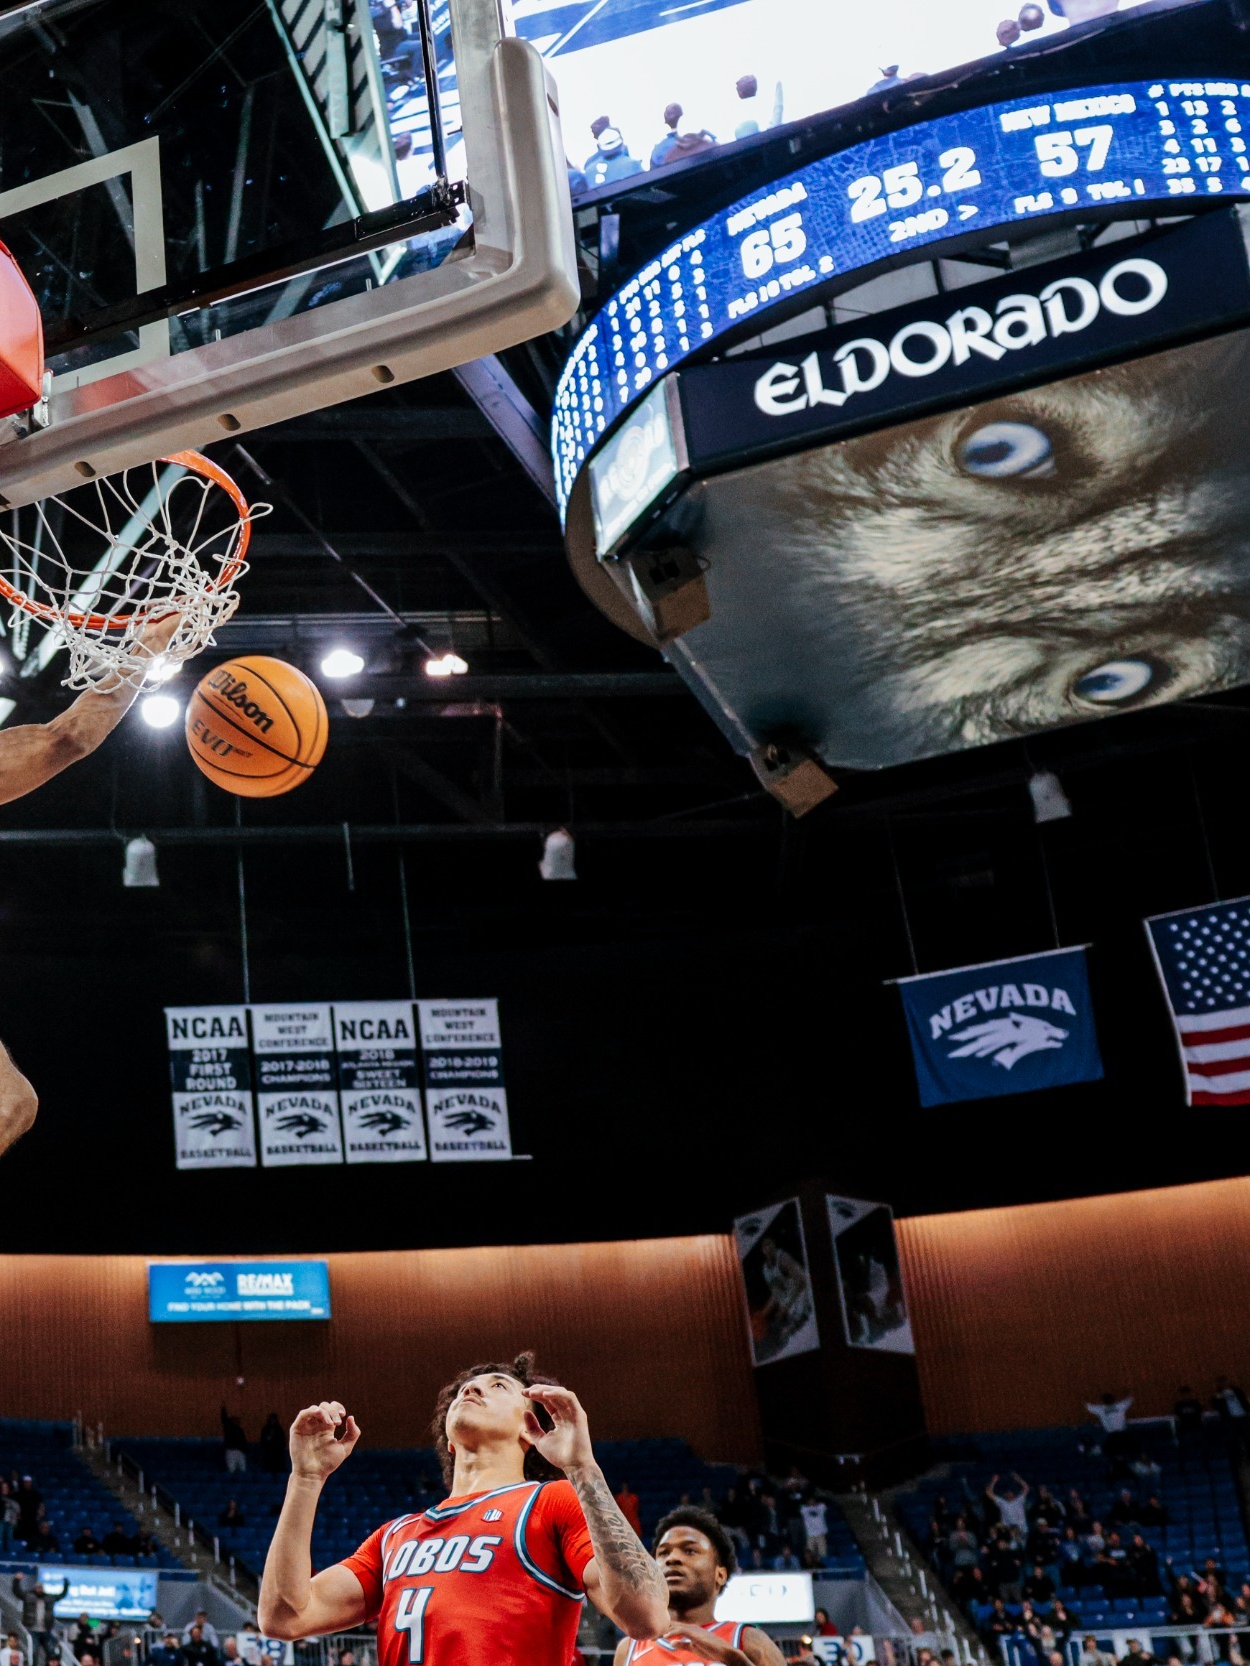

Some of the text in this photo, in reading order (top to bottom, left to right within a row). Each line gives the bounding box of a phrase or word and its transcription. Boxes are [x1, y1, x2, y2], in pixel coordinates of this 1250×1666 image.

[999, 94, 1136, 133] NEW MEXICO
[1155, 100, 1170, 116] 1
[1220, 100, 1237, 116] 2
[1191, 118, 1209, 135] 2
[1035, 124, 1114, 177] 57
[1163, 138, 1181, 154] 4
[1190, 137, 1217, 153] 11
[1195, 156, 1222, 172] 17
[847, 146, 981, 223] 25.2
[888, 208, 949, 243] 2ND
[741, 212, 807, 279] 65
[208, 669, 274, 734] Wilson
[192, 720, 234, 757] EVO
[264, 1012, 319, 1022] MOUNTAIN
[431, 1008, 487, 1017] MOUNTAIN
[929, 983, 1077, 1040] NEVADA
[172, 1016, 244, 1039] NCAA
[278, 1026, 307, 1034] WEST
[340, 1018, 410, 1040] NCAA
[445, 1021, 475, 1030] WEST
[258, 1038, 328, 1048] CONFERENCE
[426, 1033, 495, 1043] CONFERENCE
[192, 1050, 228, 1063] 2017
[189, 1062, 232, 1076] FIRST
[356, 1069, 400, 1080] SWEET
[430, 1070, 499, 1080] CHAMPIONS
[185, 1076, 237, 1091] ROUND
[261, 1073, 331, 1085] CHAMPIONS
[179, 1094, 247, 1116] NEVADA
[265, 1097, 333, 1118] NEVADA
[348, 1094, 416, 1115] NEVADA
[434, 1094, 501, 1114] NEVADA
[266, 1143, 337, 1155] BASKETBALL
[350, 1141, 421, 1152] BASKETBALL
[435, 1140, 507, 1151] BASKETBALL
[180, 1149, 252, 1159] BASKETBALL
[395, 1586, 434, 1665] 4
